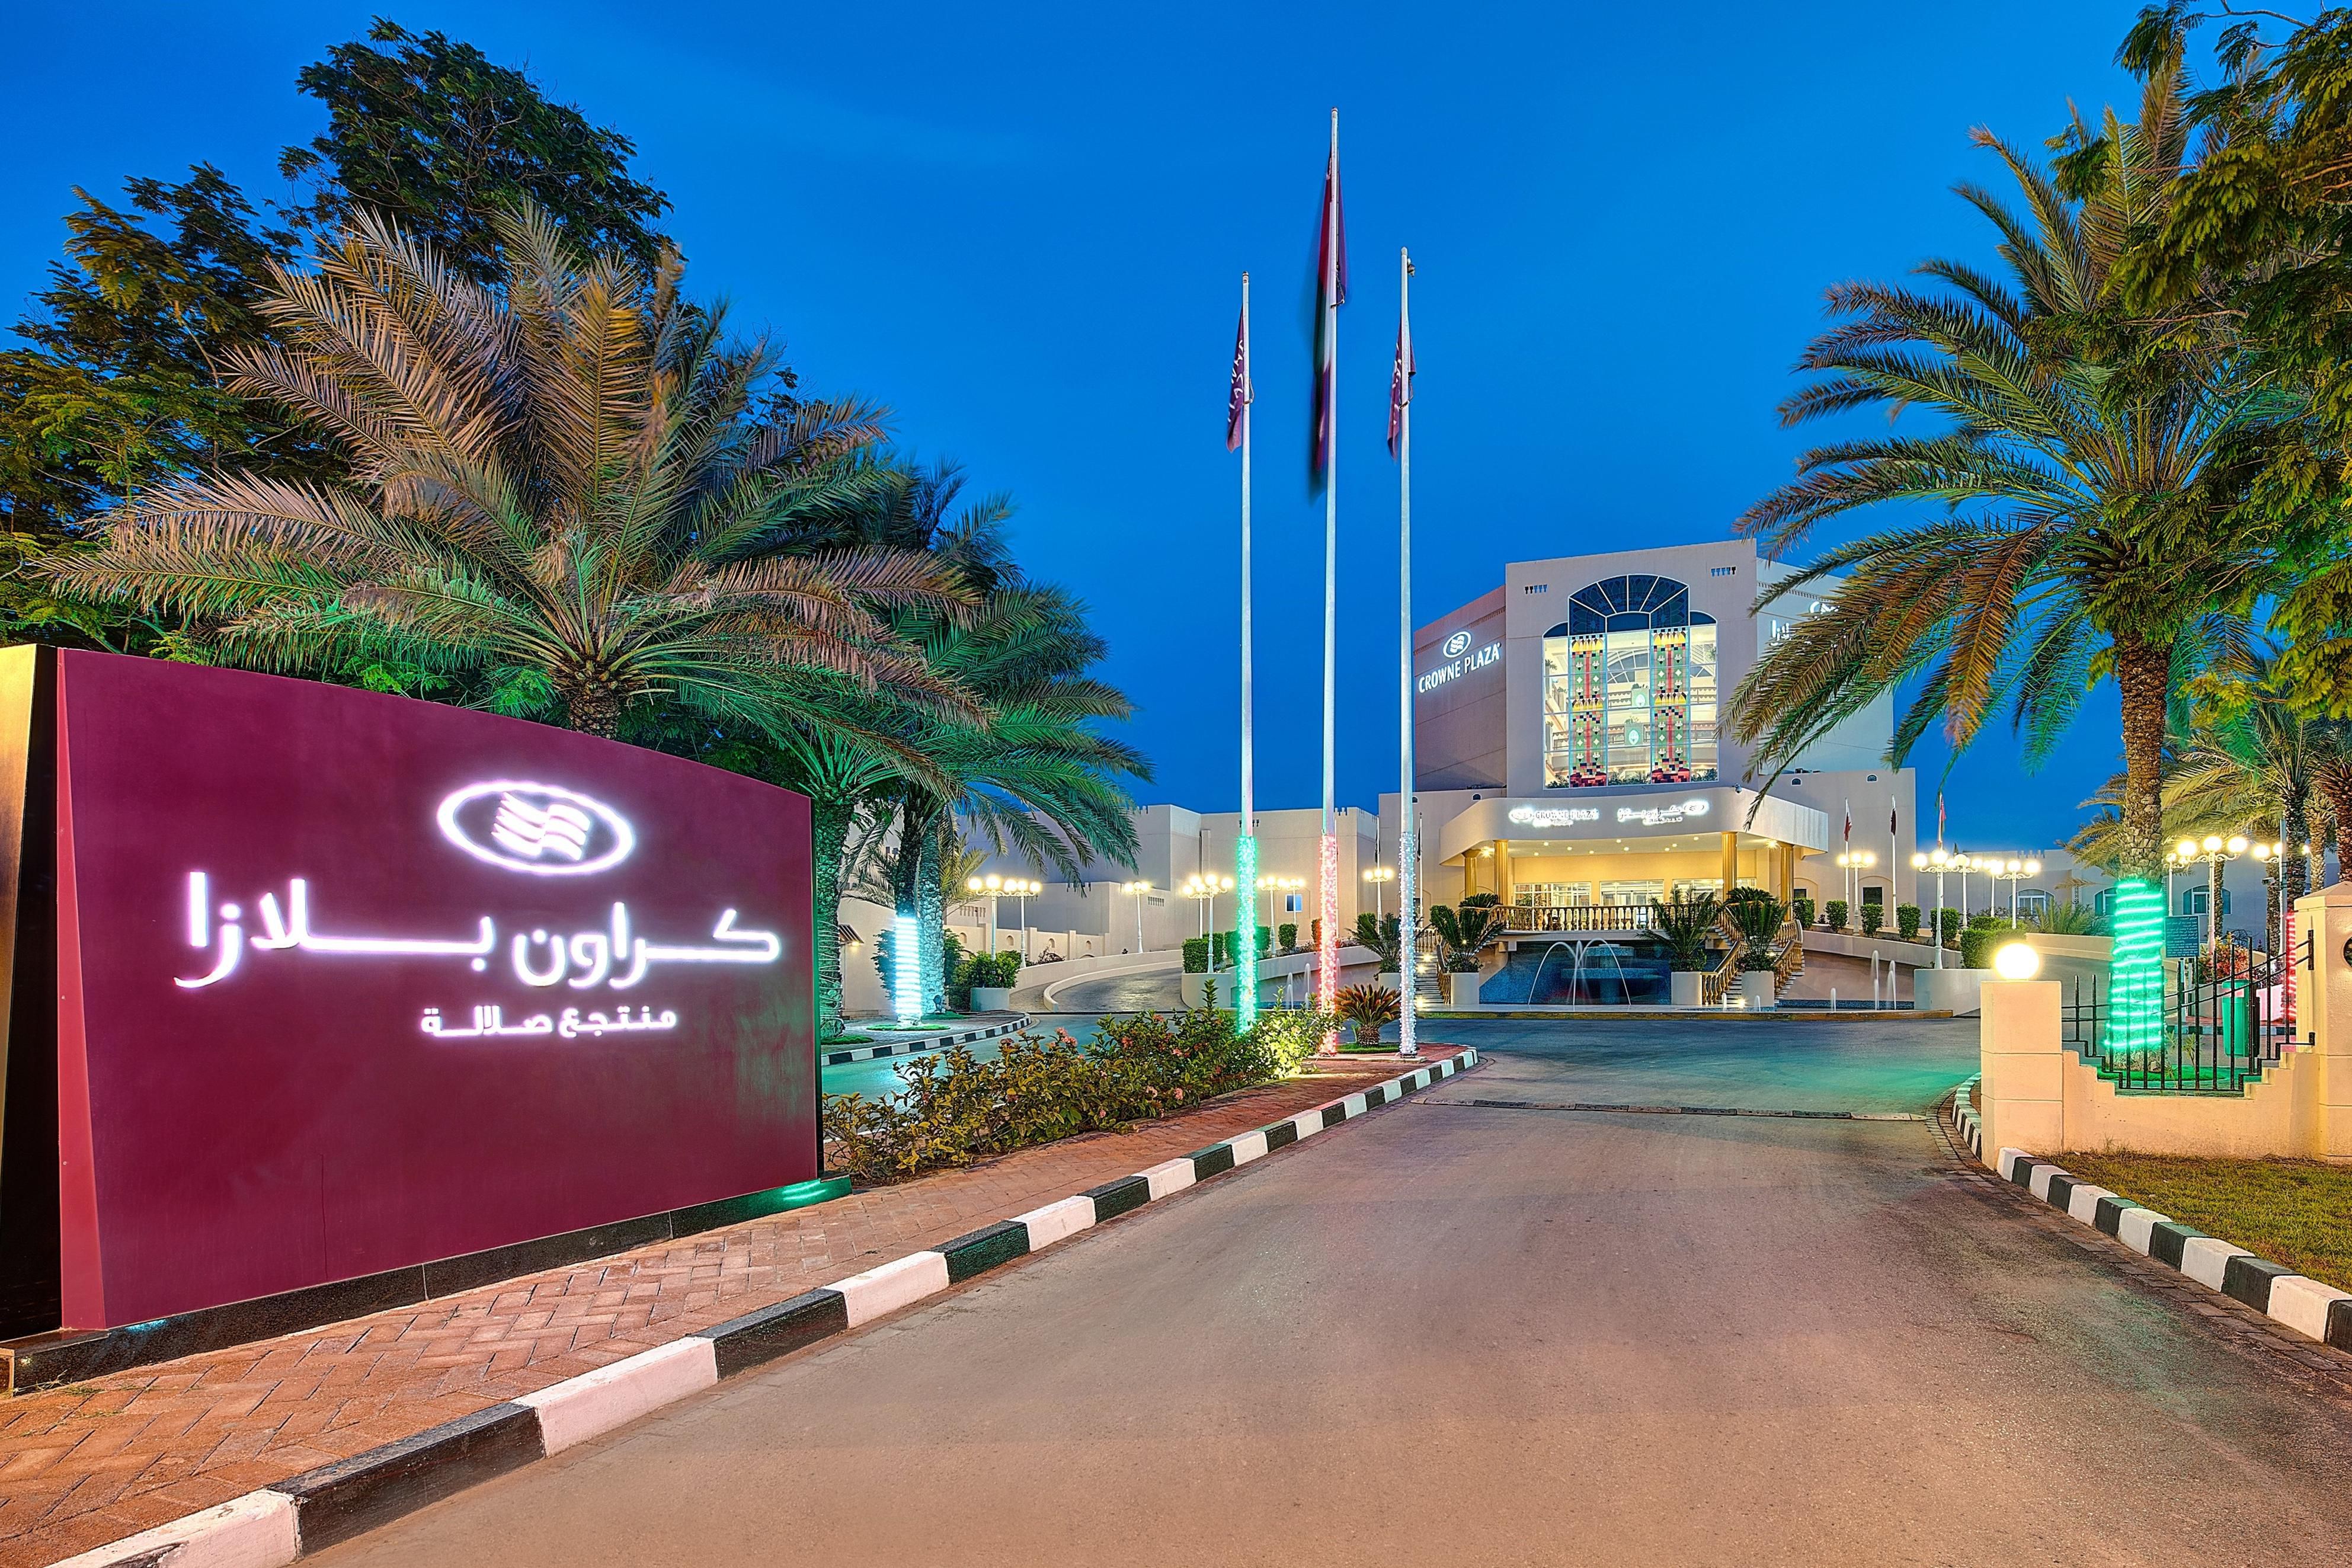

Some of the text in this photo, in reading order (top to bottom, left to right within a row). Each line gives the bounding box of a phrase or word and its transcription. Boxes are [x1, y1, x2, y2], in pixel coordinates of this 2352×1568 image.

[1418, 644, 1500, 693] CROWNE PLAZA
[174, 871, 781, 988] كراون بلازا
[421, 1005, 677, 1038] منتجع صلالة
